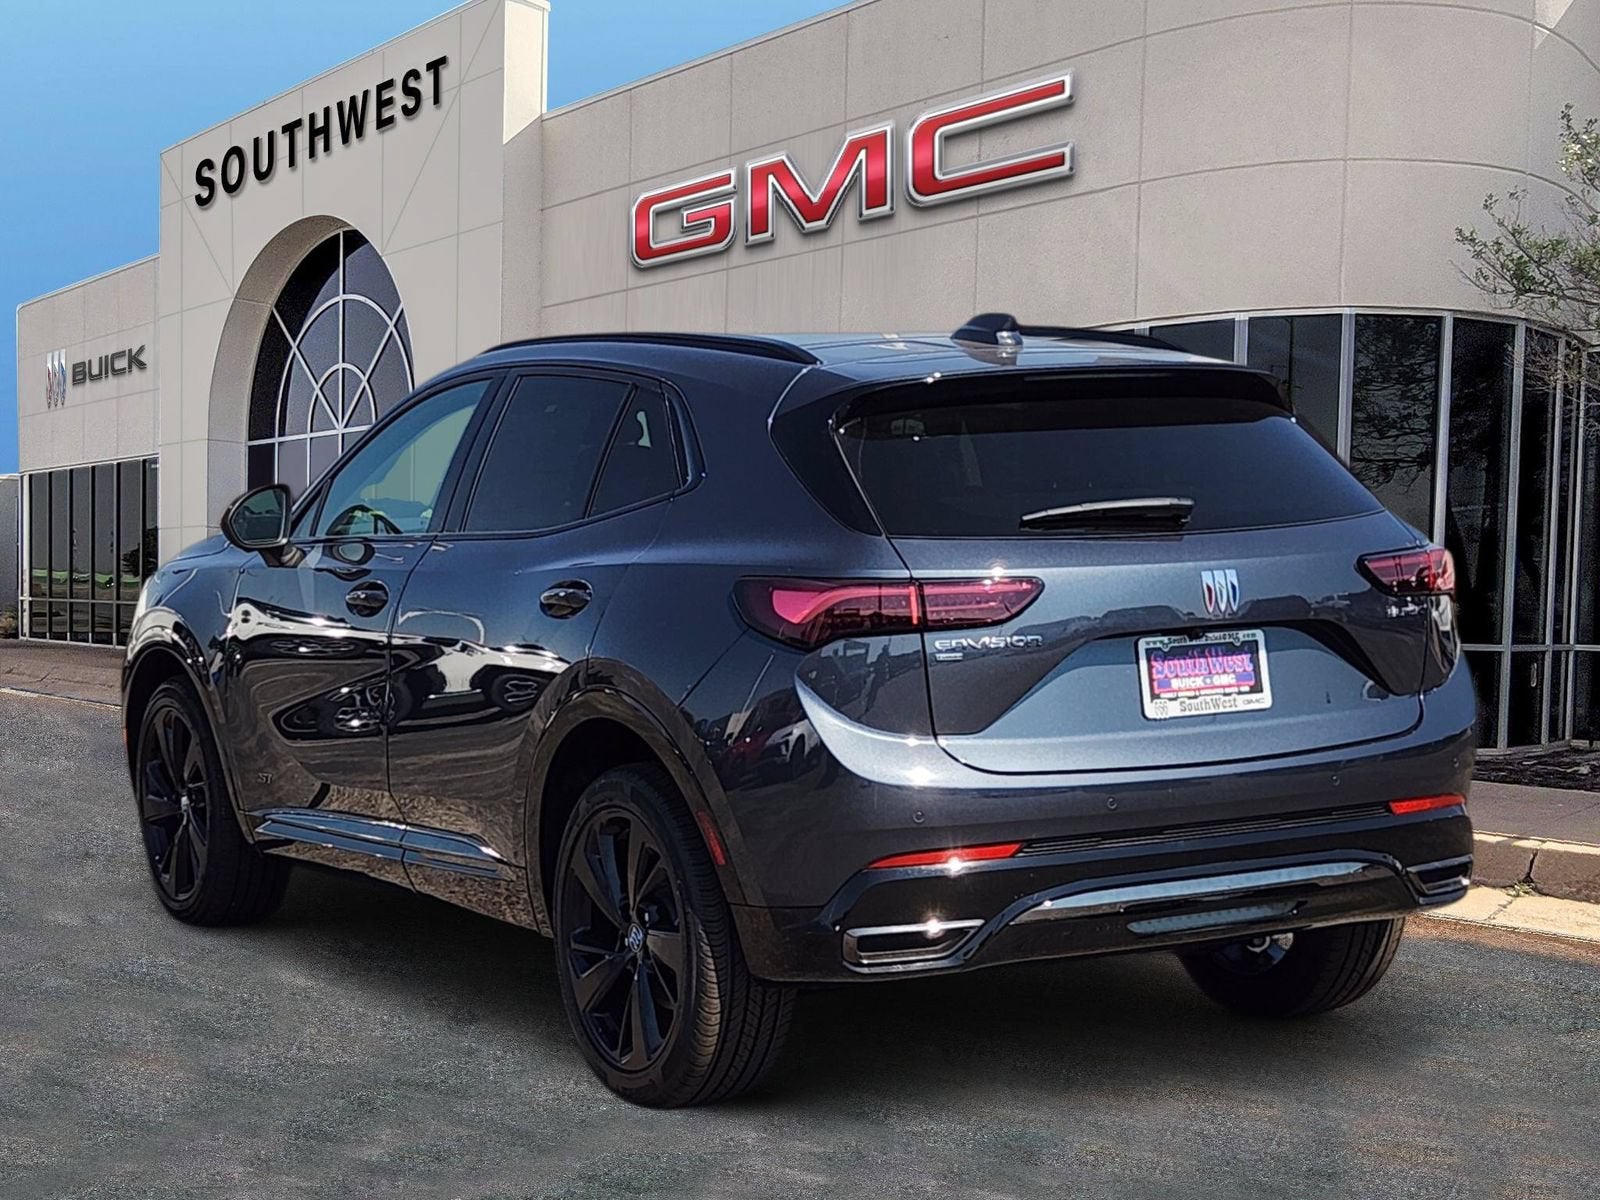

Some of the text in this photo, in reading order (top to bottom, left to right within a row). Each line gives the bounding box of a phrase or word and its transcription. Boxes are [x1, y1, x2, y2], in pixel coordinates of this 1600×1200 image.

[194, 55, 449, 208] SOUTHWEST
[629, 68, 1076, 269] GMC
[72, 344, 147, 386] BUICK
[934, 635, 1043, 651] ENVISION
[1170, 673, 1237, 690] BUICK GMC
[1179, 697, 1239, 713] SouthWest
